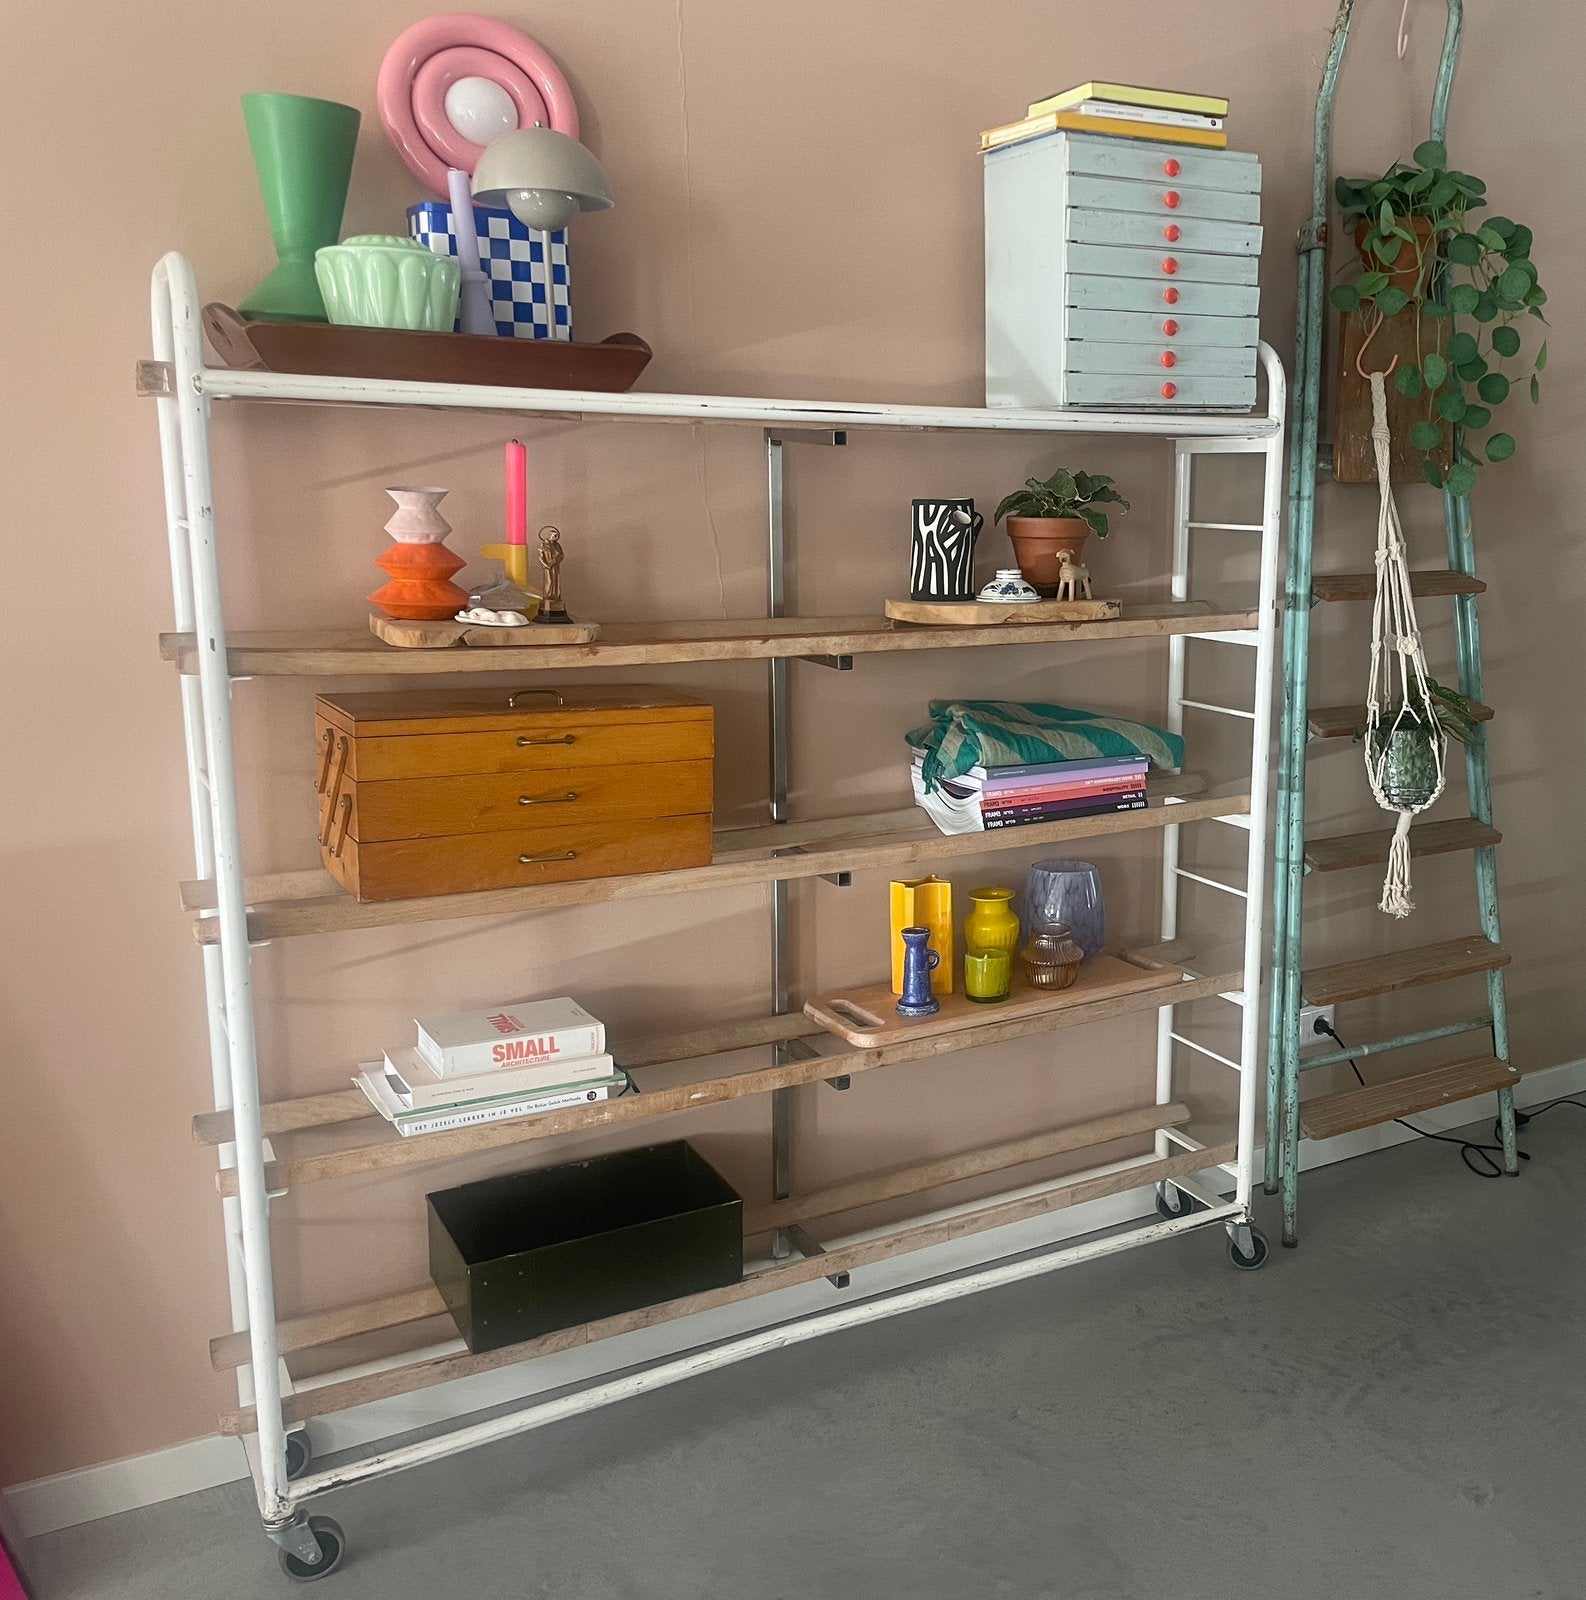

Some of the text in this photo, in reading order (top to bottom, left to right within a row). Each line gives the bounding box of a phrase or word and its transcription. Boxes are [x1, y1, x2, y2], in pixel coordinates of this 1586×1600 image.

[493, 1036, 560, 1063] SMALL
[501, 1055, 551, 1068] ARCHITECTURE
[459, 1113, 485, 1123] LEKKER
